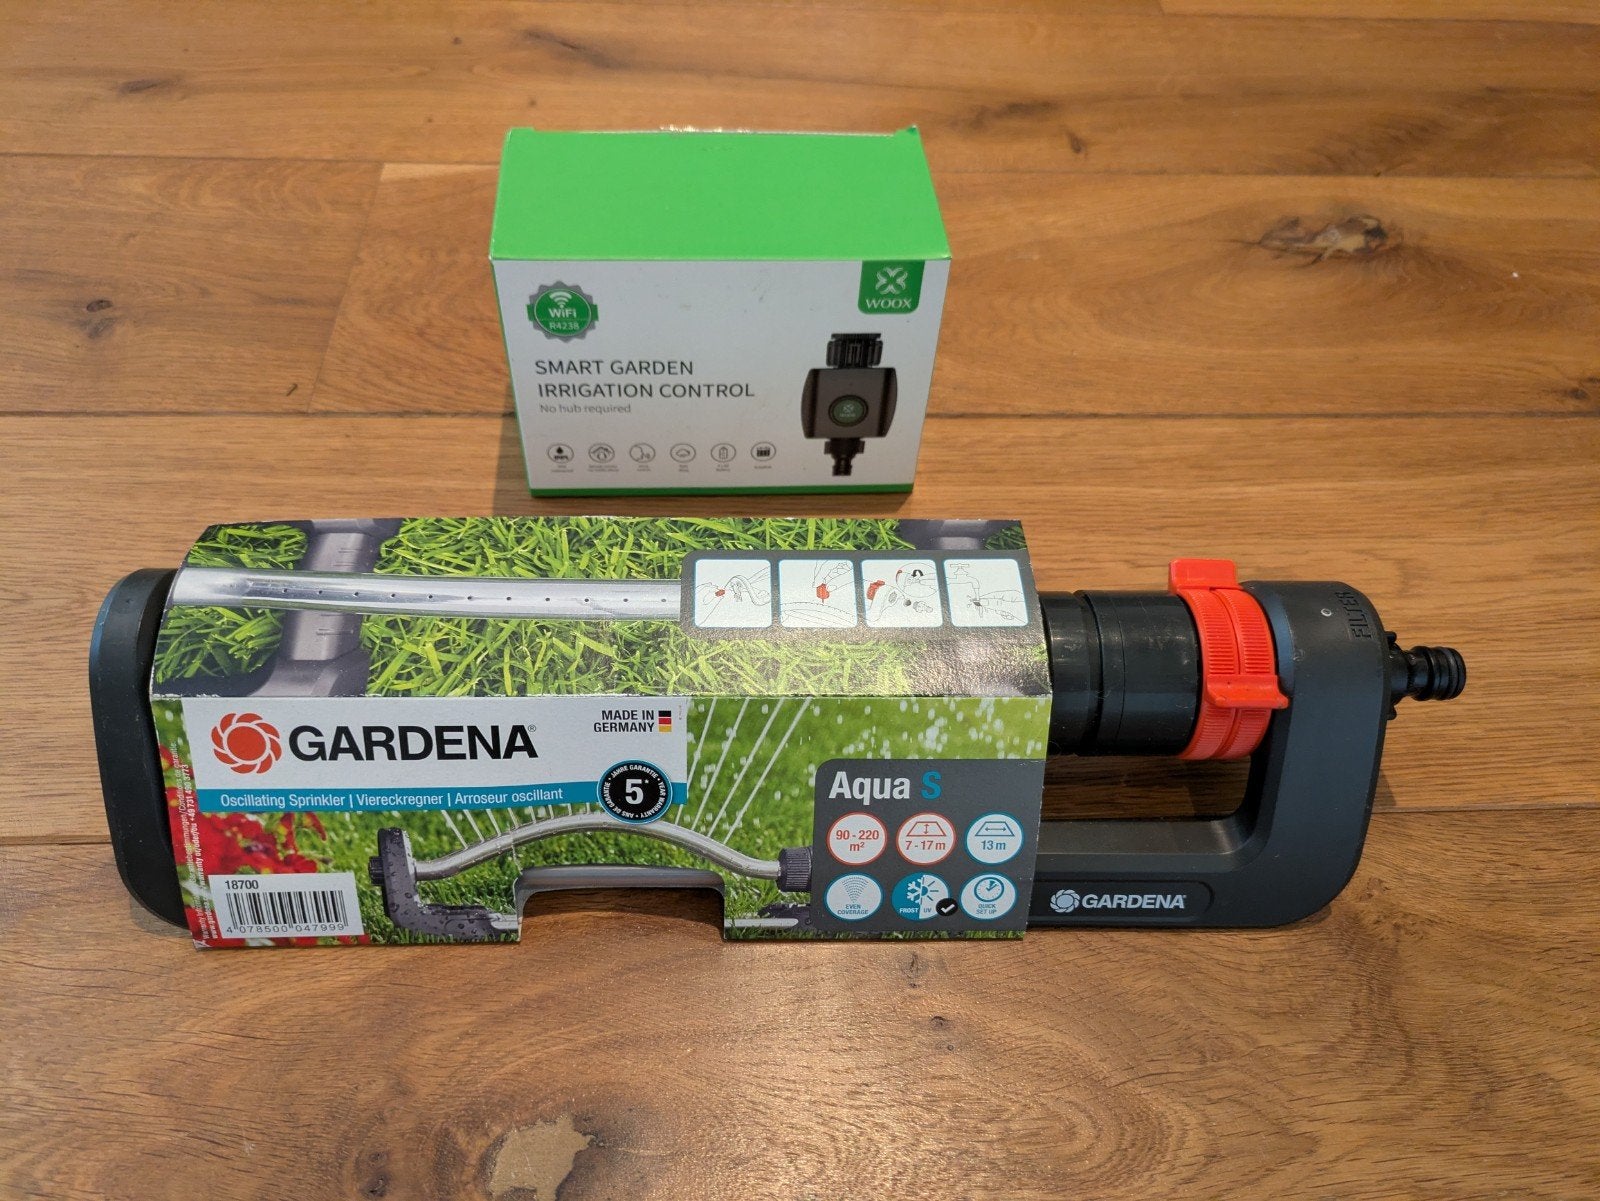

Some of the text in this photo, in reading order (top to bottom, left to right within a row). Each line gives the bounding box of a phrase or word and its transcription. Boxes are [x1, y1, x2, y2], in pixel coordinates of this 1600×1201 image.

[866, 298, 912, 309] WOOX
[548, 308, 577, 318] WiFi
[535, 360, 694, 376] SMART GARDEN
[538, 382, 755, 398] IRRIGATION CONTROL
[540, 403, 631, 416] No hub required
[1335, 591, 1372, 638] FILTER
[602, 710, 654, 720] MADE IN
[594, 722, 654, 732] GERMANY
[181, 764, 190, 780] 3773
[610, 764, 658, 778] JAHRE GARANTIE
[658, 781, 666, 796] YEAR
[828, 770, 942, 805] Aqua S
[186, 796, 194, 807] 731
[220, 794, 286, 808] Oscillating
[288, 794, 346, 808] Sprinkler
[356, 793, 443, 808] Viereckregner
[454, 792, 508, 804] Arroseur
[511, 788, 564, 802] oscillant
[603, 782, 634, 818] ANS DE GARANTIE
[640, 797, 665, 818] WARRANTY
[836, 830, 850, 841] 90
[858, 830, 880, 841] 220
[905, 840, 911, 851] 7
[922, 840, 932, 851] 17
[935, 842, 946, 851] m
[982, 840, 1006, 851] 13 m
[225, 880, 259, 890] 18700
[240, 925, 288, 934] 078500
[296, 923, 345, 932] 047999
